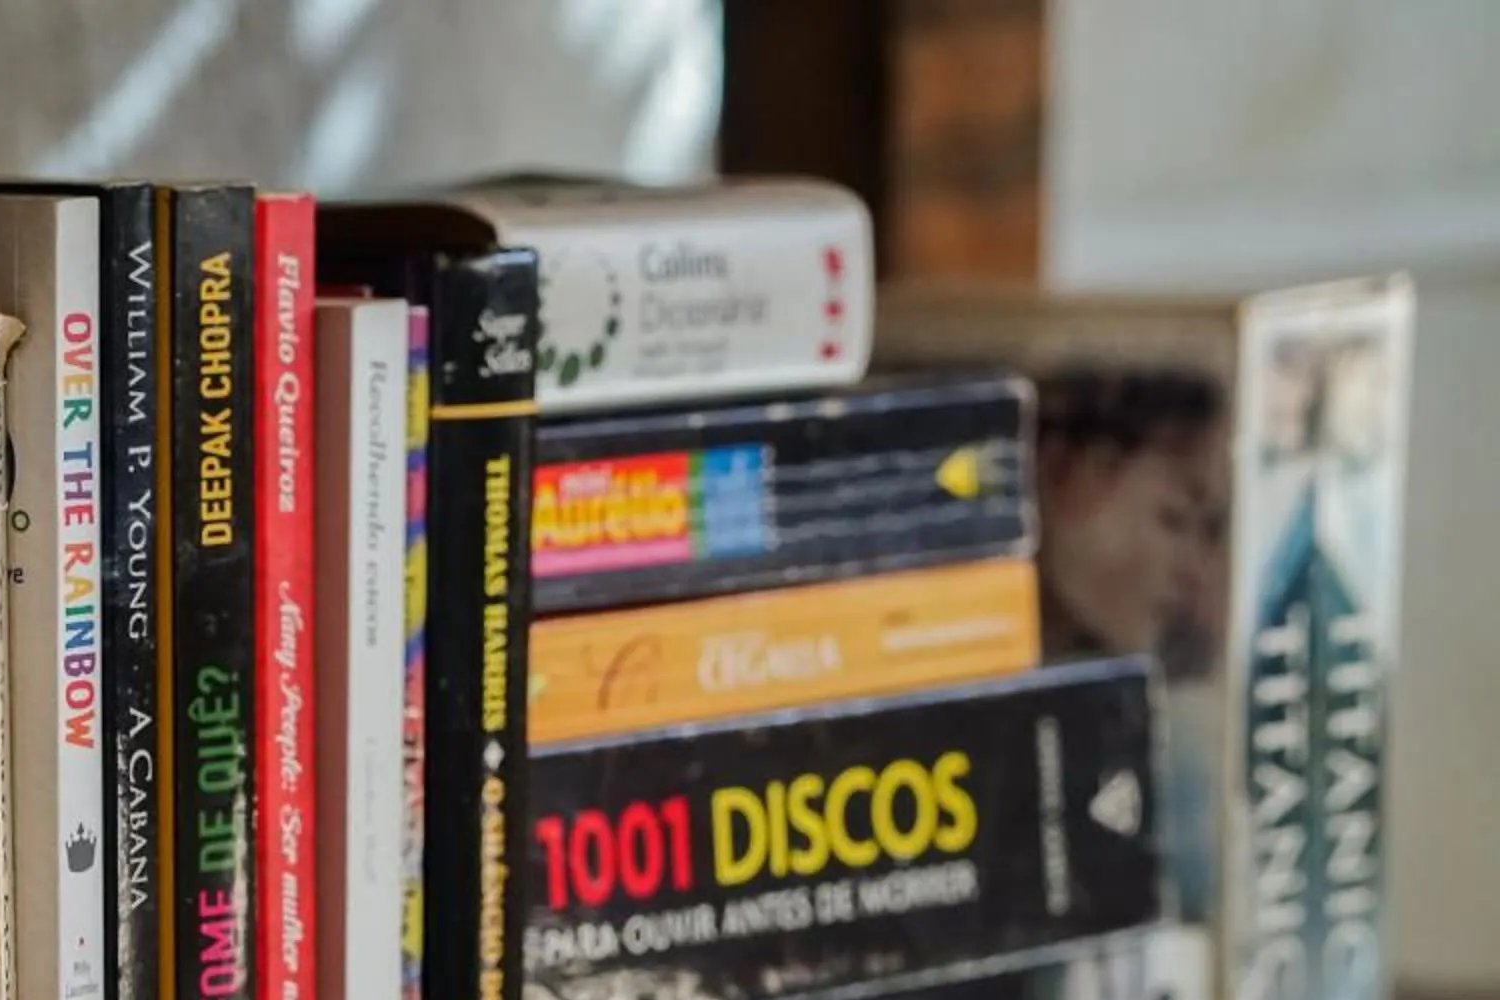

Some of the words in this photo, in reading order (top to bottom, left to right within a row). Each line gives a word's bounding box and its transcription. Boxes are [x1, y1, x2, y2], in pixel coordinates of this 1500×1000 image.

[63, 313, 92, 429] OVER
[127, 241, 152, 423] WILLIAM
[201, 252, 232, 400] CHOPRA
[63, 442, 93, 527] THE
[127, 445, 152, 472] P.
[201, 408, 232, 547] DEEPAK
[274, 372, 299, 513] Queiroz
[128, 489, 152, 639] YOUNG
[63, 542, 97, 748] RAINBOW
[128, 707, 153, 738] A
[188, 666, 240, 794] QUÊ?
[129, 750, 153, 910] CABANA
[199, 812, 237, 873] DE
[534, 794, 693, 911] 1001
[711, 751, 978, 887] DISCOS
[1252, 605, 1310, 1000] TITANIC
[1323, 610, 1380, 990] TITANIC
[281, 873, 306, 972] mulher
[544, 921, 619, 966] PARA
[623, 902, 717, 955] OUVIR
[721, 887, 813, 939] ANTES
[815, 879, 855, 924] DE
